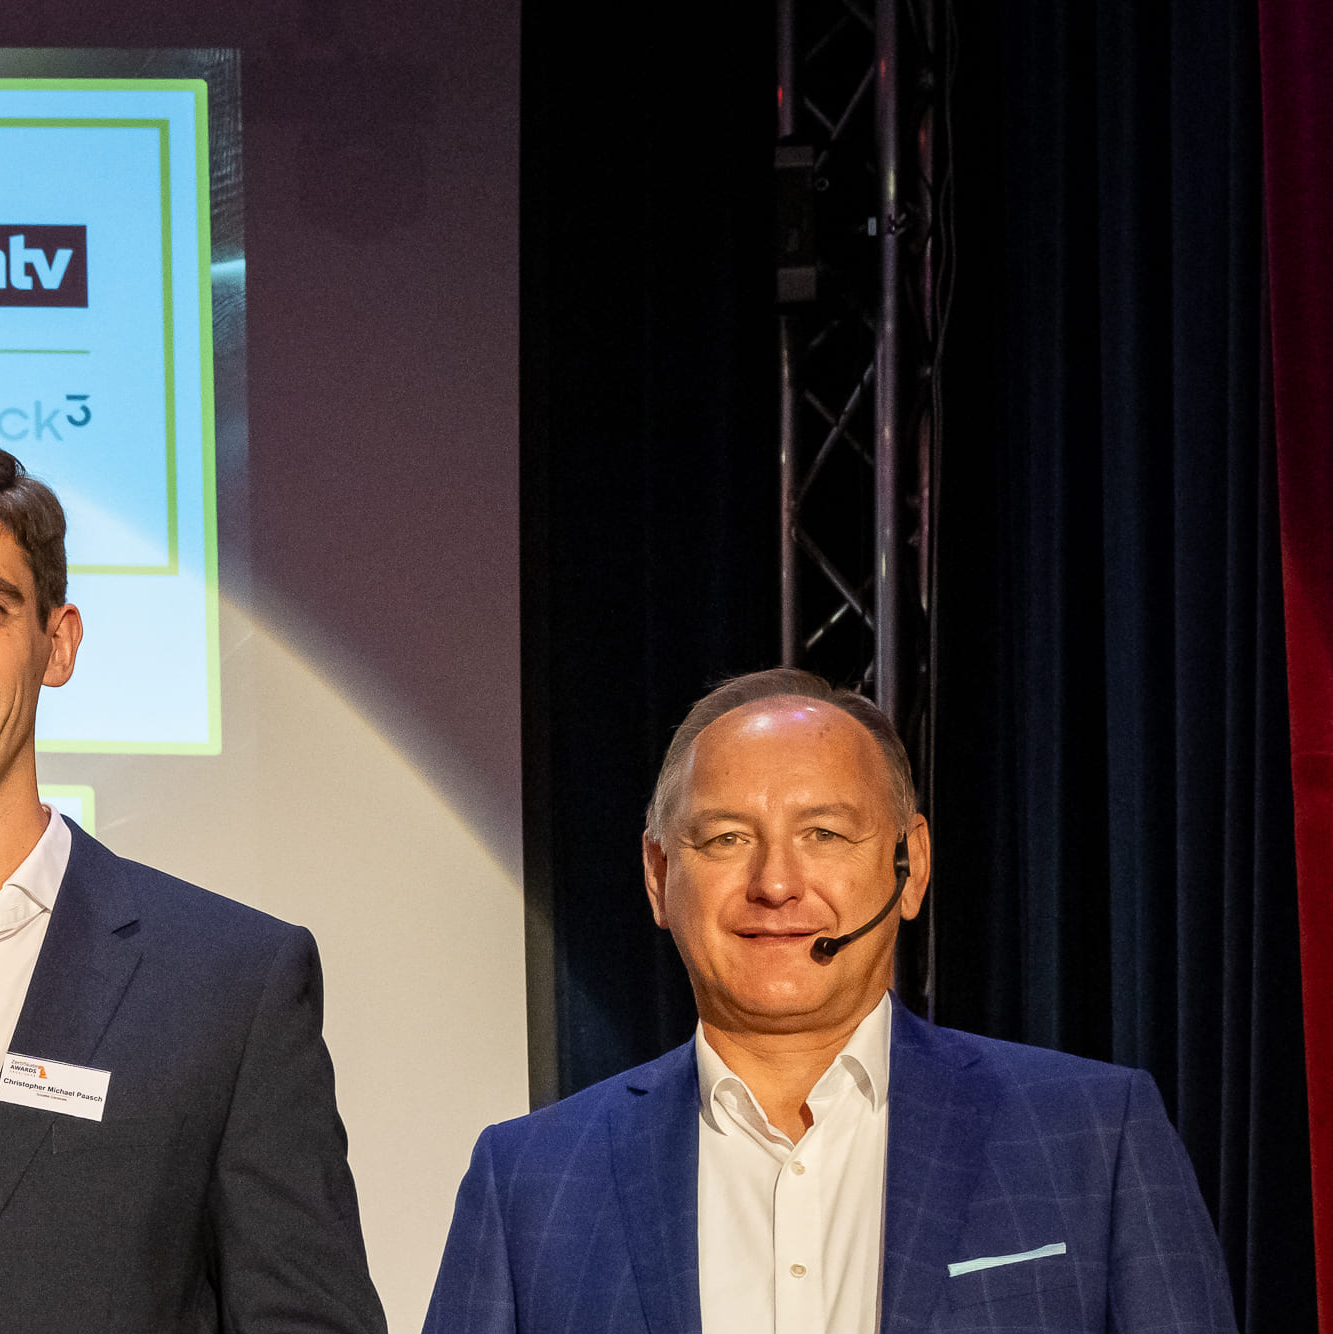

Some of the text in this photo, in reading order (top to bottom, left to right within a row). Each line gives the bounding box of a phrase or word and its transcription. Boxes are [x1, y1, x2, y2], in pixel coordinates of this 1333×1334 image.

[10, 1064, 37, 1074] AWARDS
[3, 1077, 46, 1091] Christopher
[47, 1086, 75, 1097] Michael
[76, 1091, 103, 1103] Paasch
